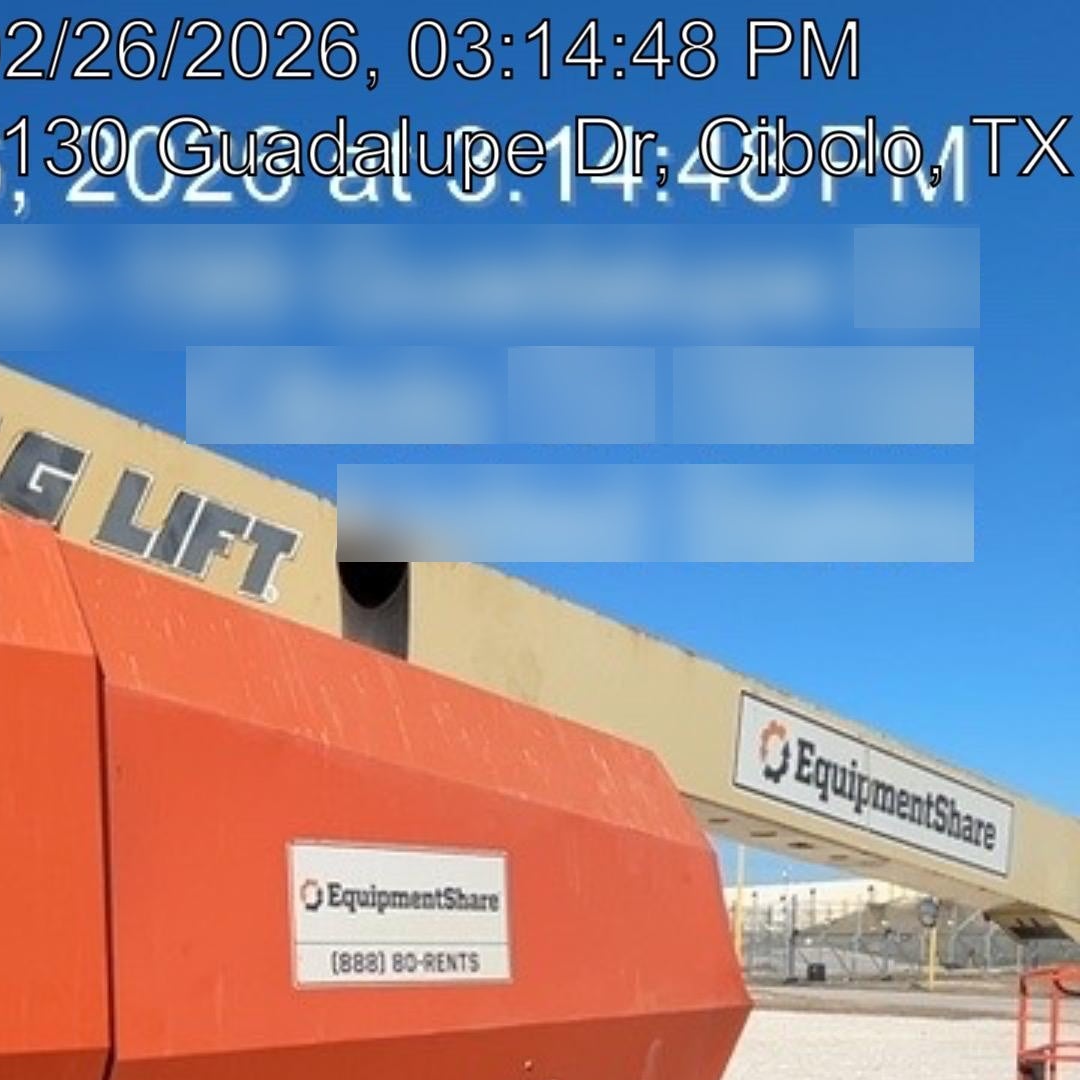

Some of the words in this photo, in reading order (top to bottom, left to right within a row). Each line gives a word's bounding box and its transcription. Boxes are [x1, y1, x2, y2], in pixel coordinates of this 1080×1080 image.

[90, 467, 303, 602] LIFT
[794, 737, 998, 851] EquipmentShare
[326, 882, 500, 914] EquipmentShare
[332, 950, 385, 975] (888)
[392, 951, 480, 973] 80-RENTS
